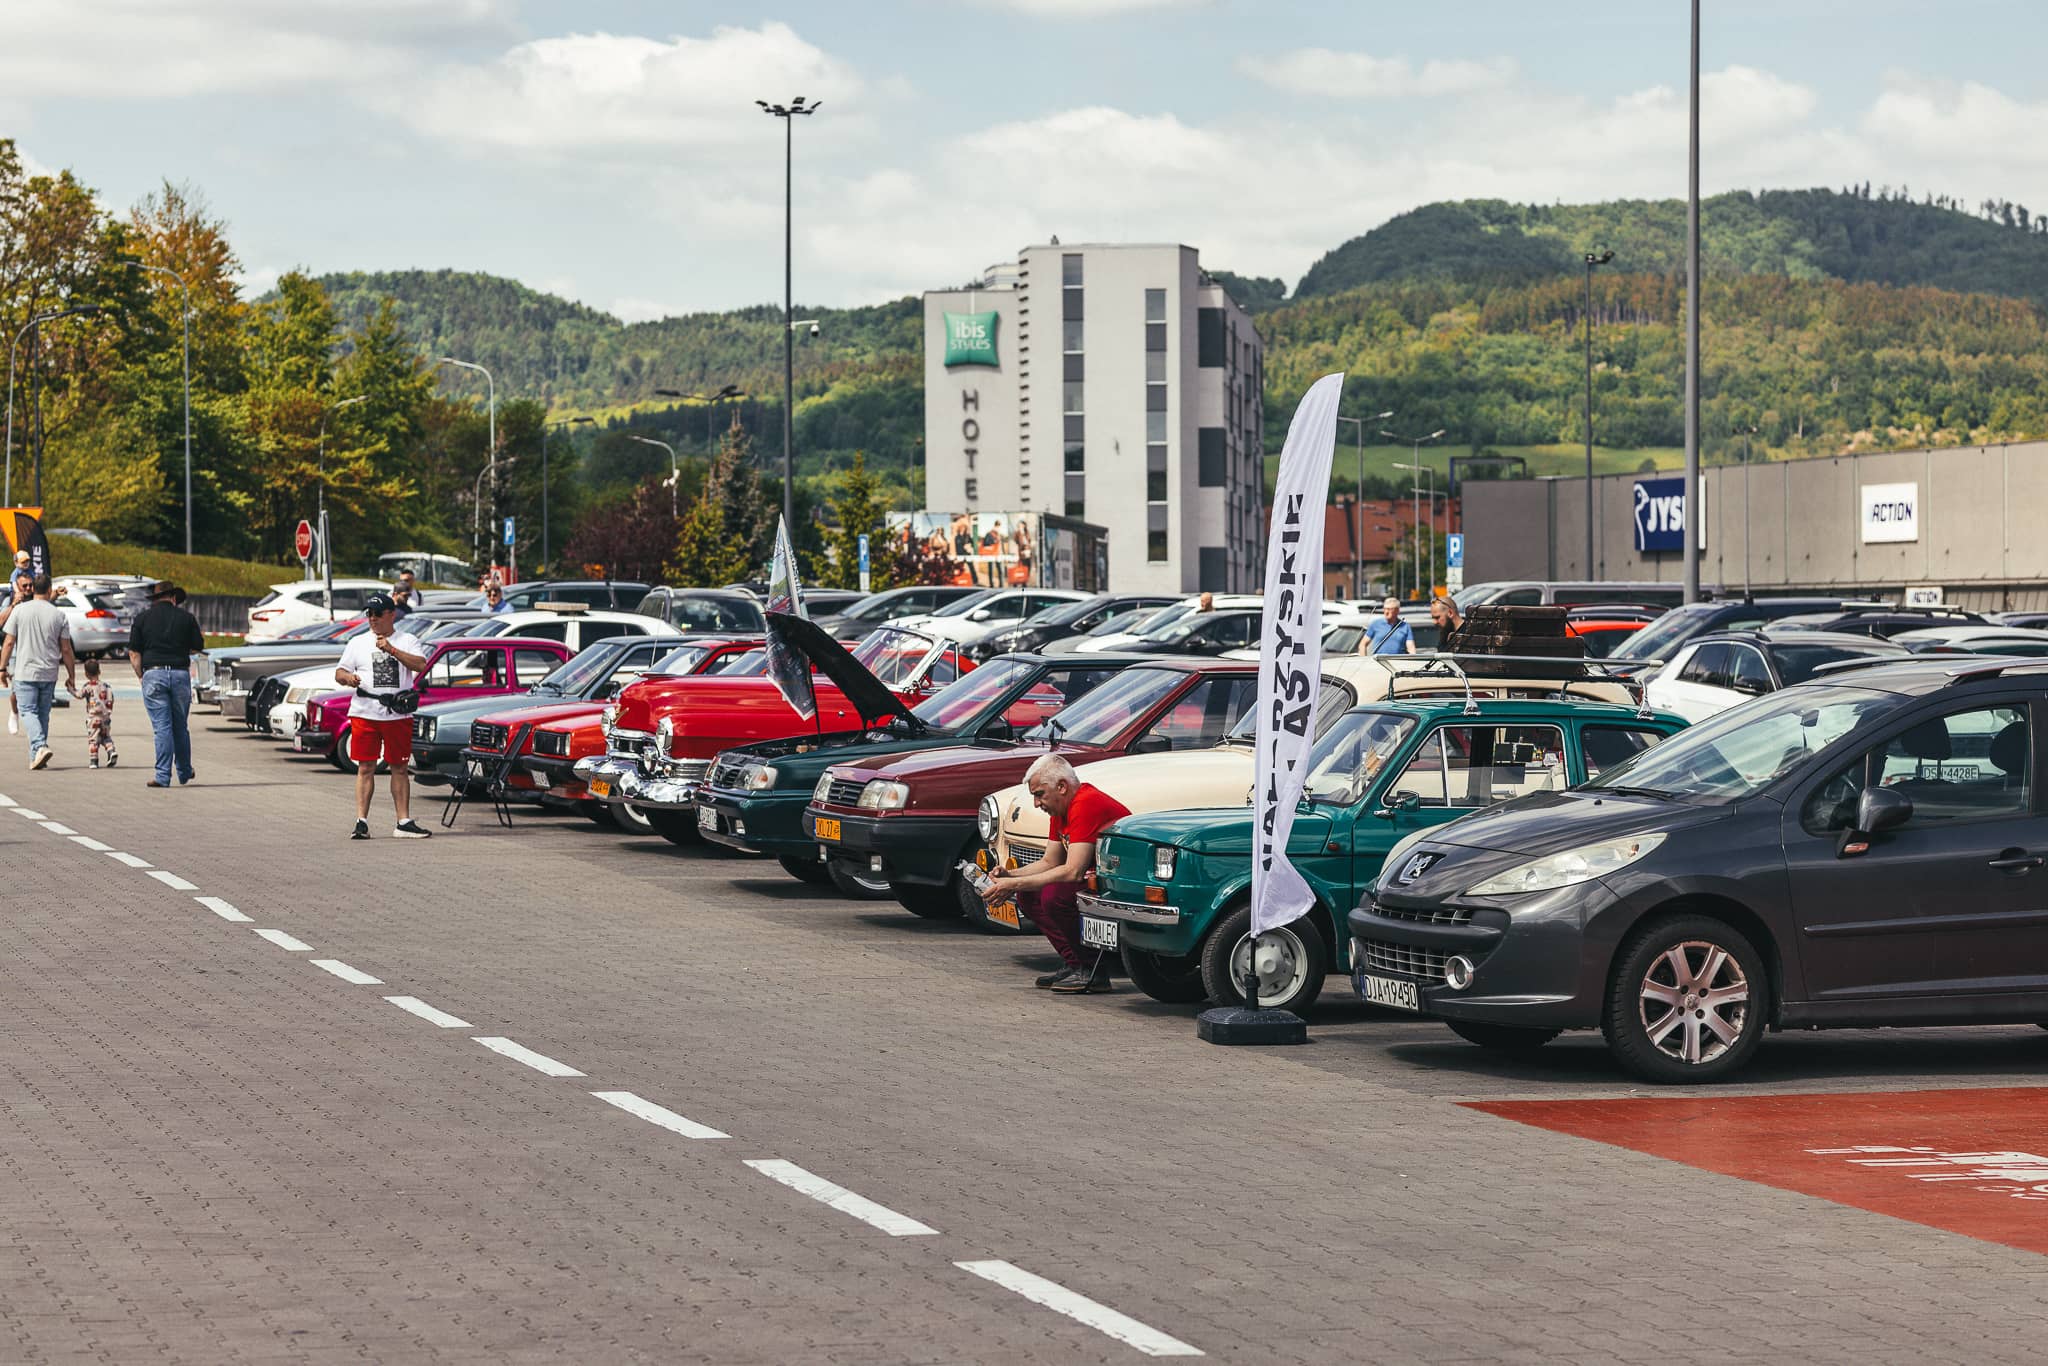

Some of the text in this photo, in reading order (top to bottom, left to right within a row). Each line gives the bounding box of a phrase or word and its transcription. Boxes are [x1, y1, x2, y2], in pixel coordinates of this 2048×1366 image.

[956, 320, 986, 338] ibis
[962, 388, 979, 511] HOTE
[1872, 502, 1912, 521] ACTION
[297, 533, 310, 546] STOP
[505, 520, 513, 542] P
[860, 538, 868, 561] P
[1450, 536, 1460, 559] P
[1914, 591, 1938, 603] ACTION
